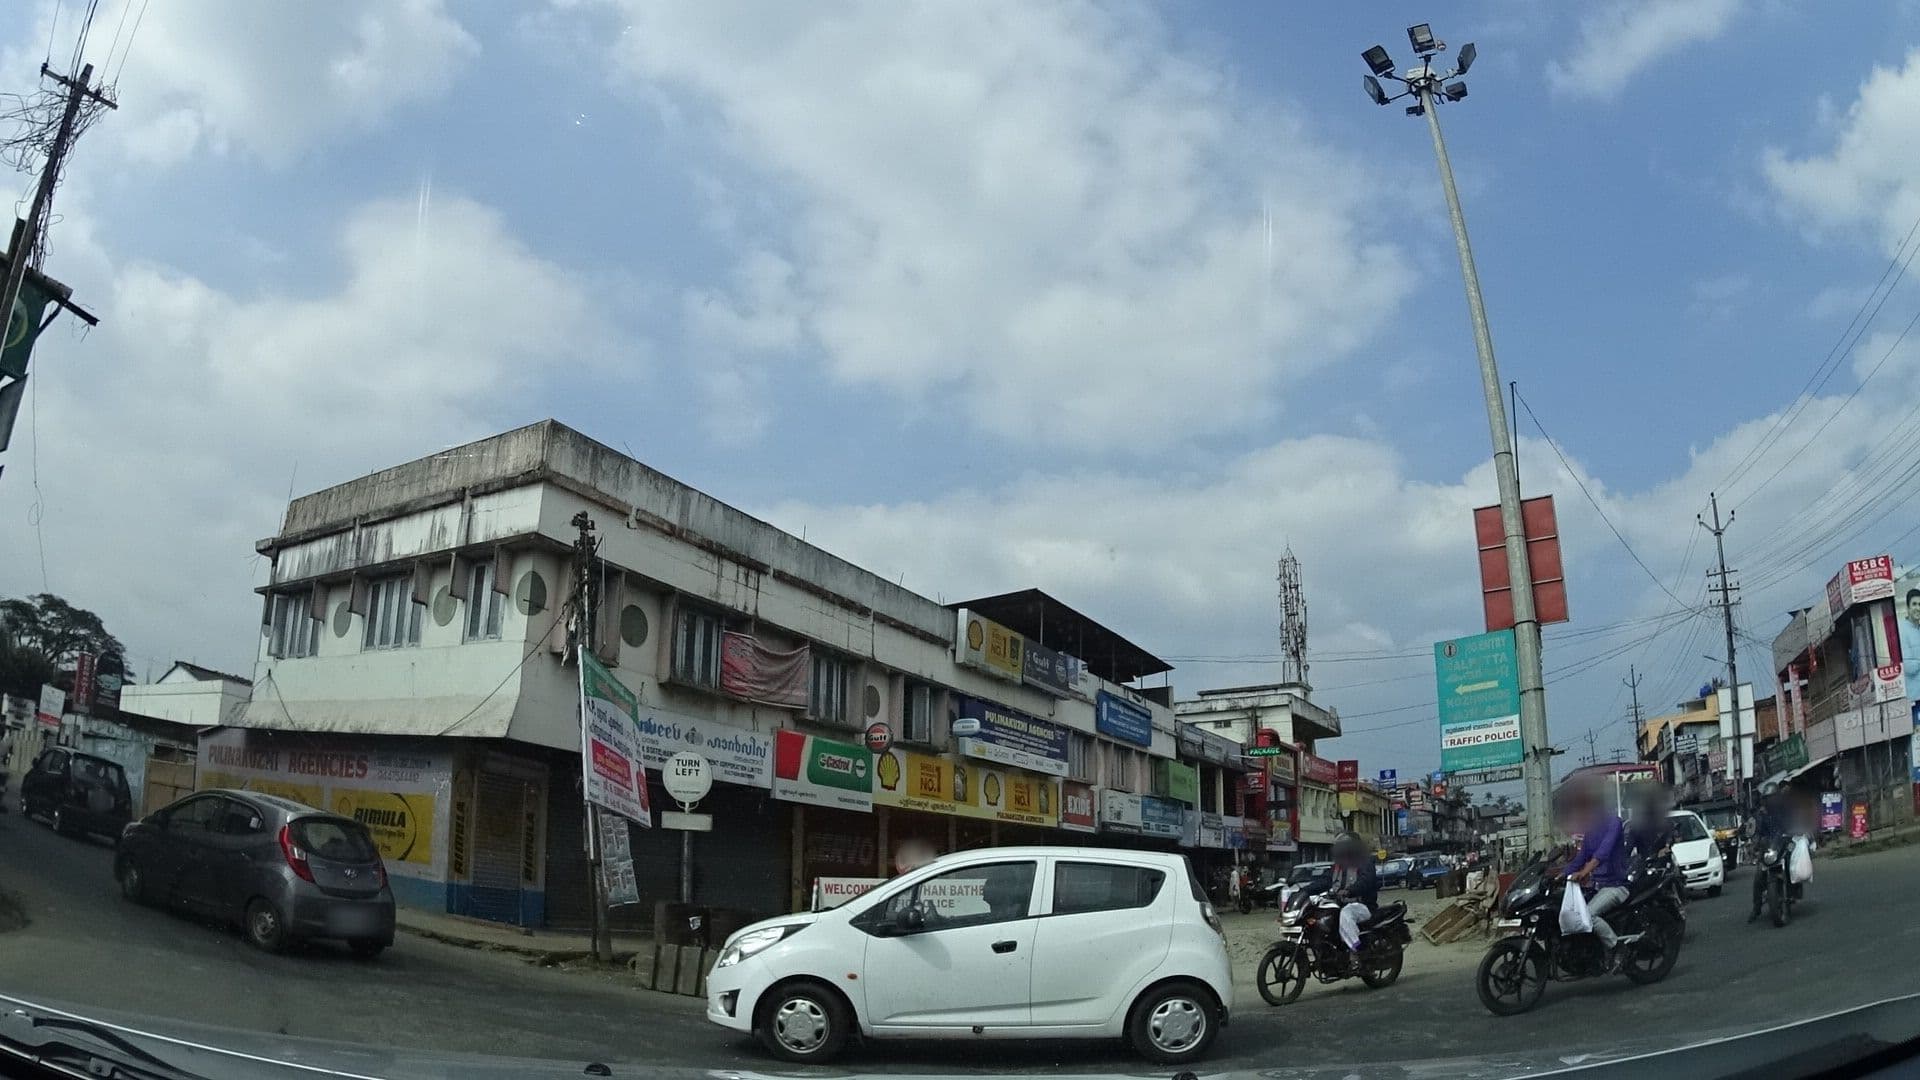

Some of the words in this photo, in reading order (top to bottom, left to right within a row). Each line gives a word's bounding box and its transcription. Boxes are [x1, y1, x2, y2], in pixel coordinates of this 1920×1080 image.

[1852, 557, 1885, 571] KSBC
[1032, 651, 1050, 669] Gulf
[1444, 735, 1482, 747] TRAFFIC
[1484, 729, 1519, 743] POLICE
[287, 751, 369, 779] AGENCIES
[675, 759, 700, 768] TURN
[826, 755, 850, 771] Castrol
[675, 768, 700, 777] LEFT
[1068, 795, 1091, 817] EXIDE
[824, 883, 876, 895] WELCOM
